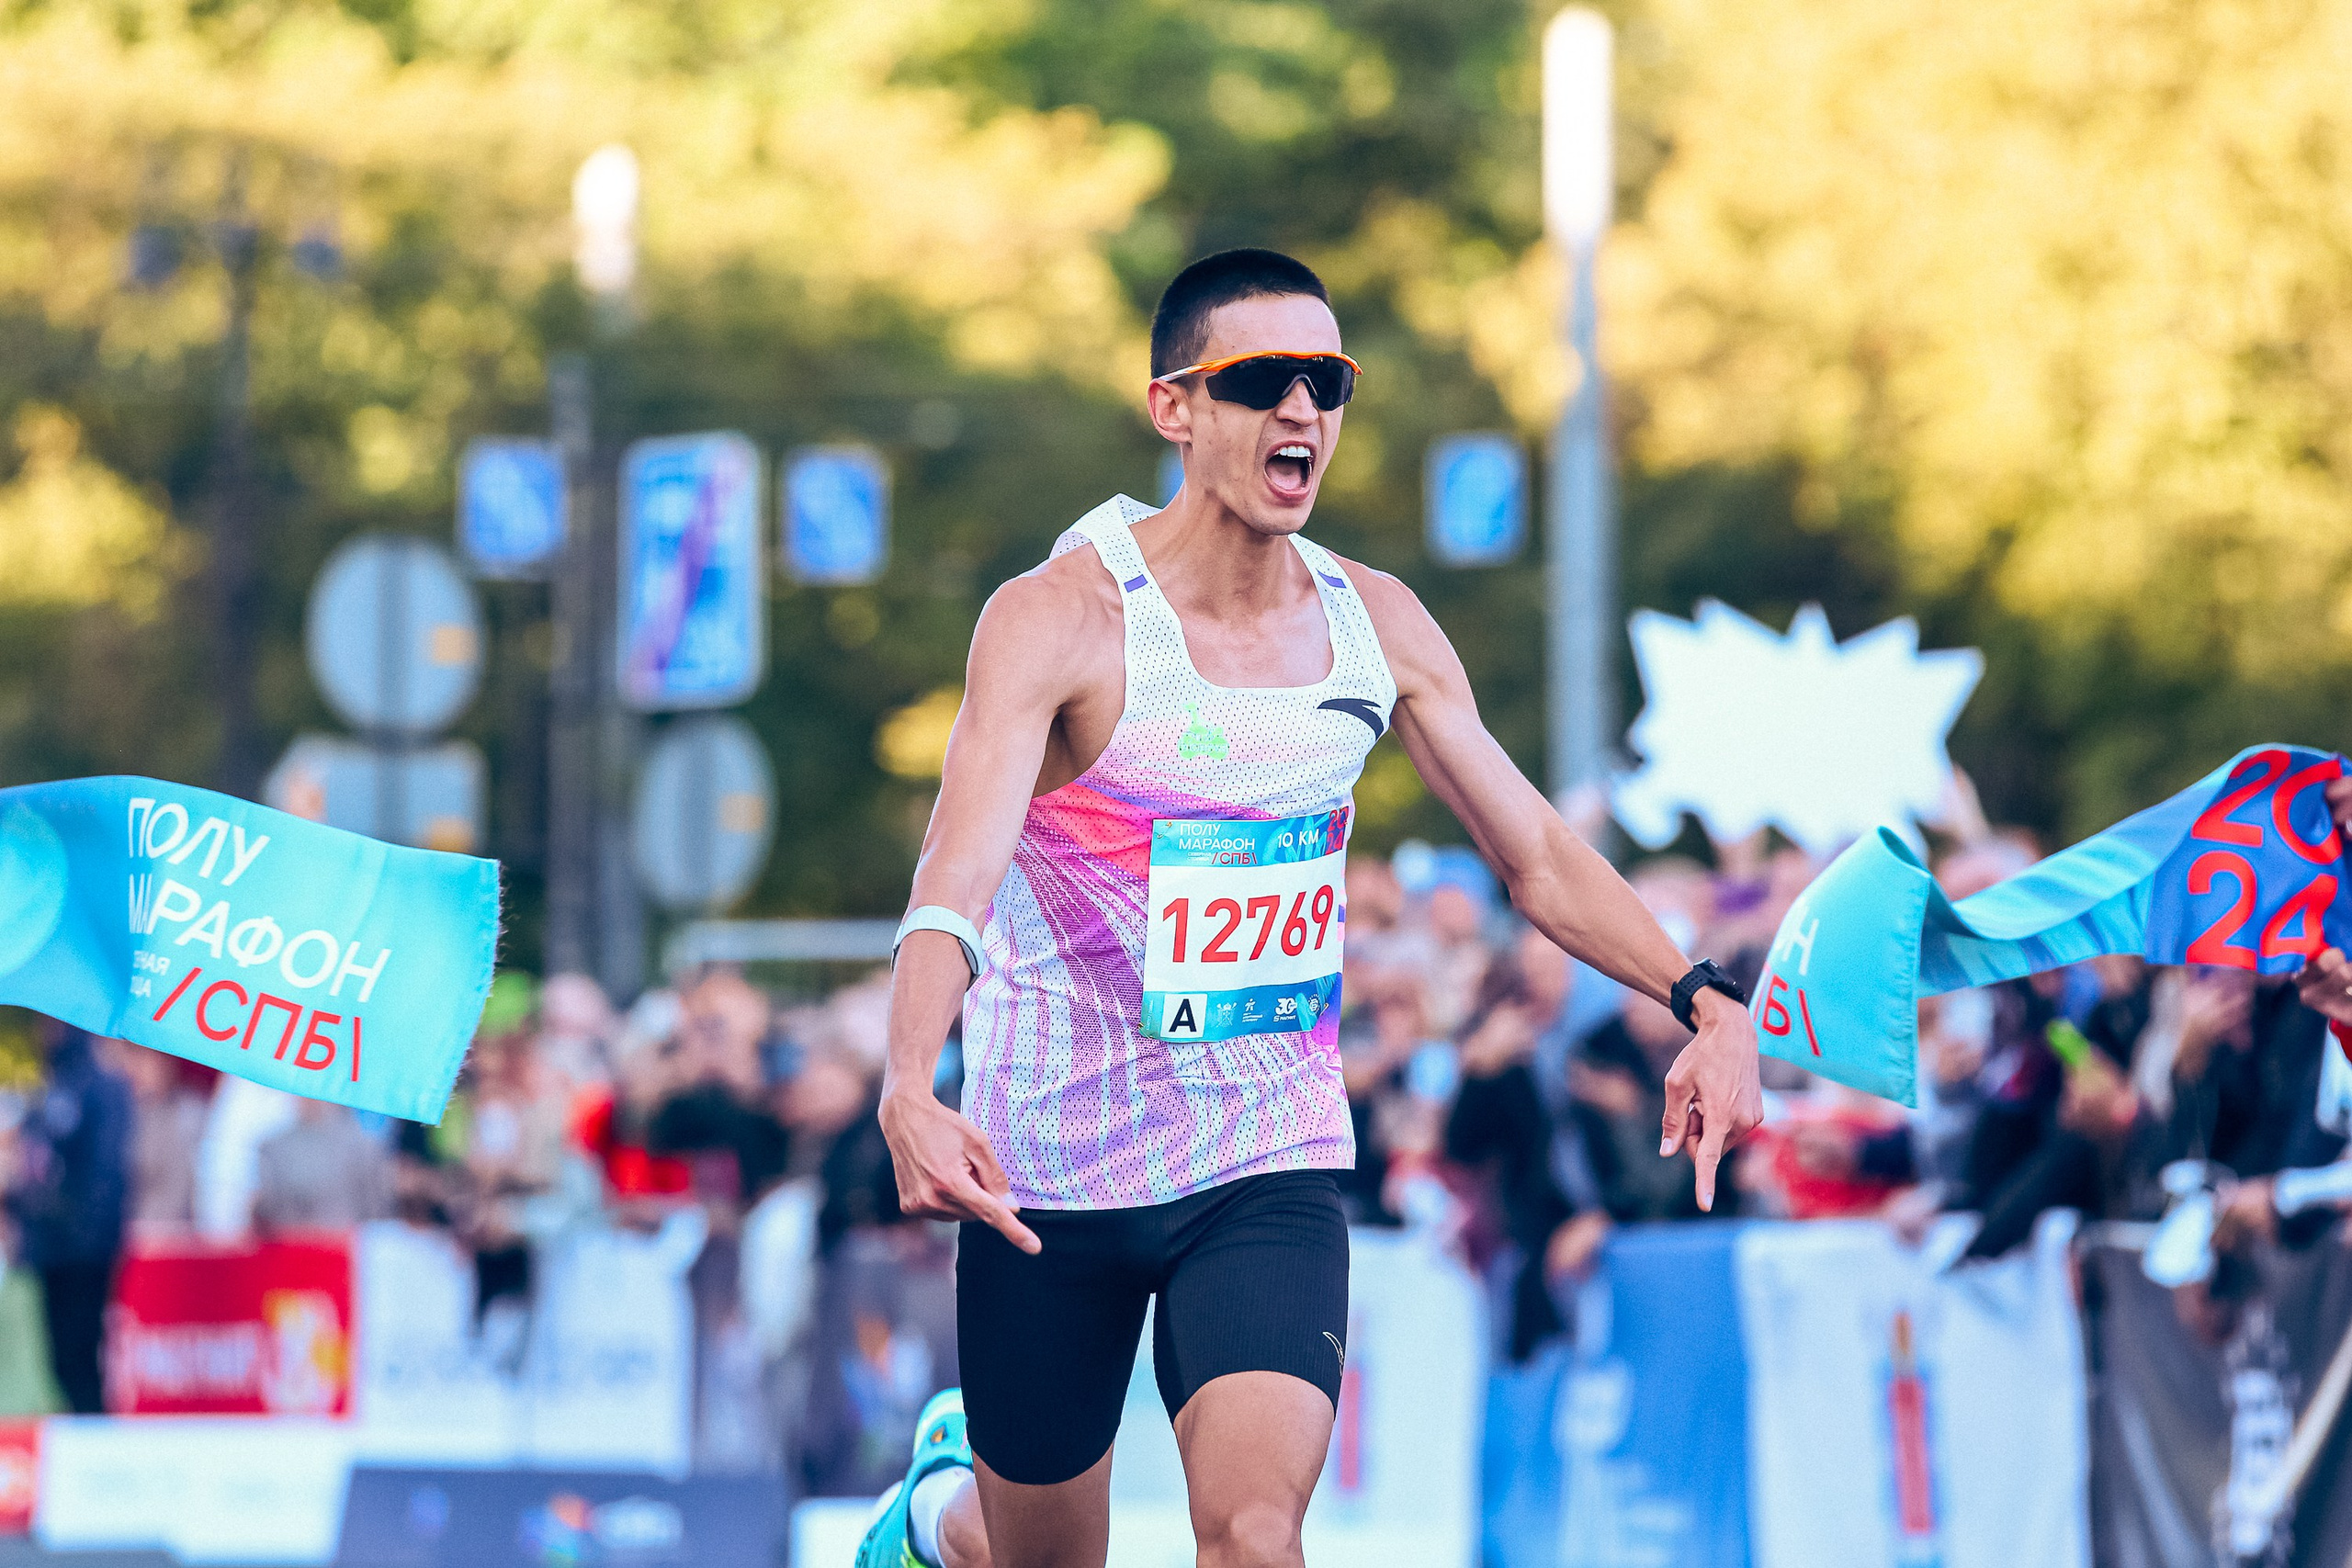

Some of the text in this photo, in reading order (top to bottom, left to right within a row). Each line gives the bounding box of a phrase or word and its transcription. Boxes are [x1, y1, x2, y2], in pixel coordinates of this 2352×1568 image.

[128, 797, 270, 886] ПОЛУ
[1179, 837, 1255, 851] МАРАФОН
[1180, 823, 1222, 836] ПОЛУ
[1277, 829, 1319, 848] 10 КМ
[1211, 852, 1257, 865] /СПБ\
[1162, 885, 1334, 963] 12769
[2187, 850, 2338, 971] 24
[153, 966, 360, 1082] /СПБ\
